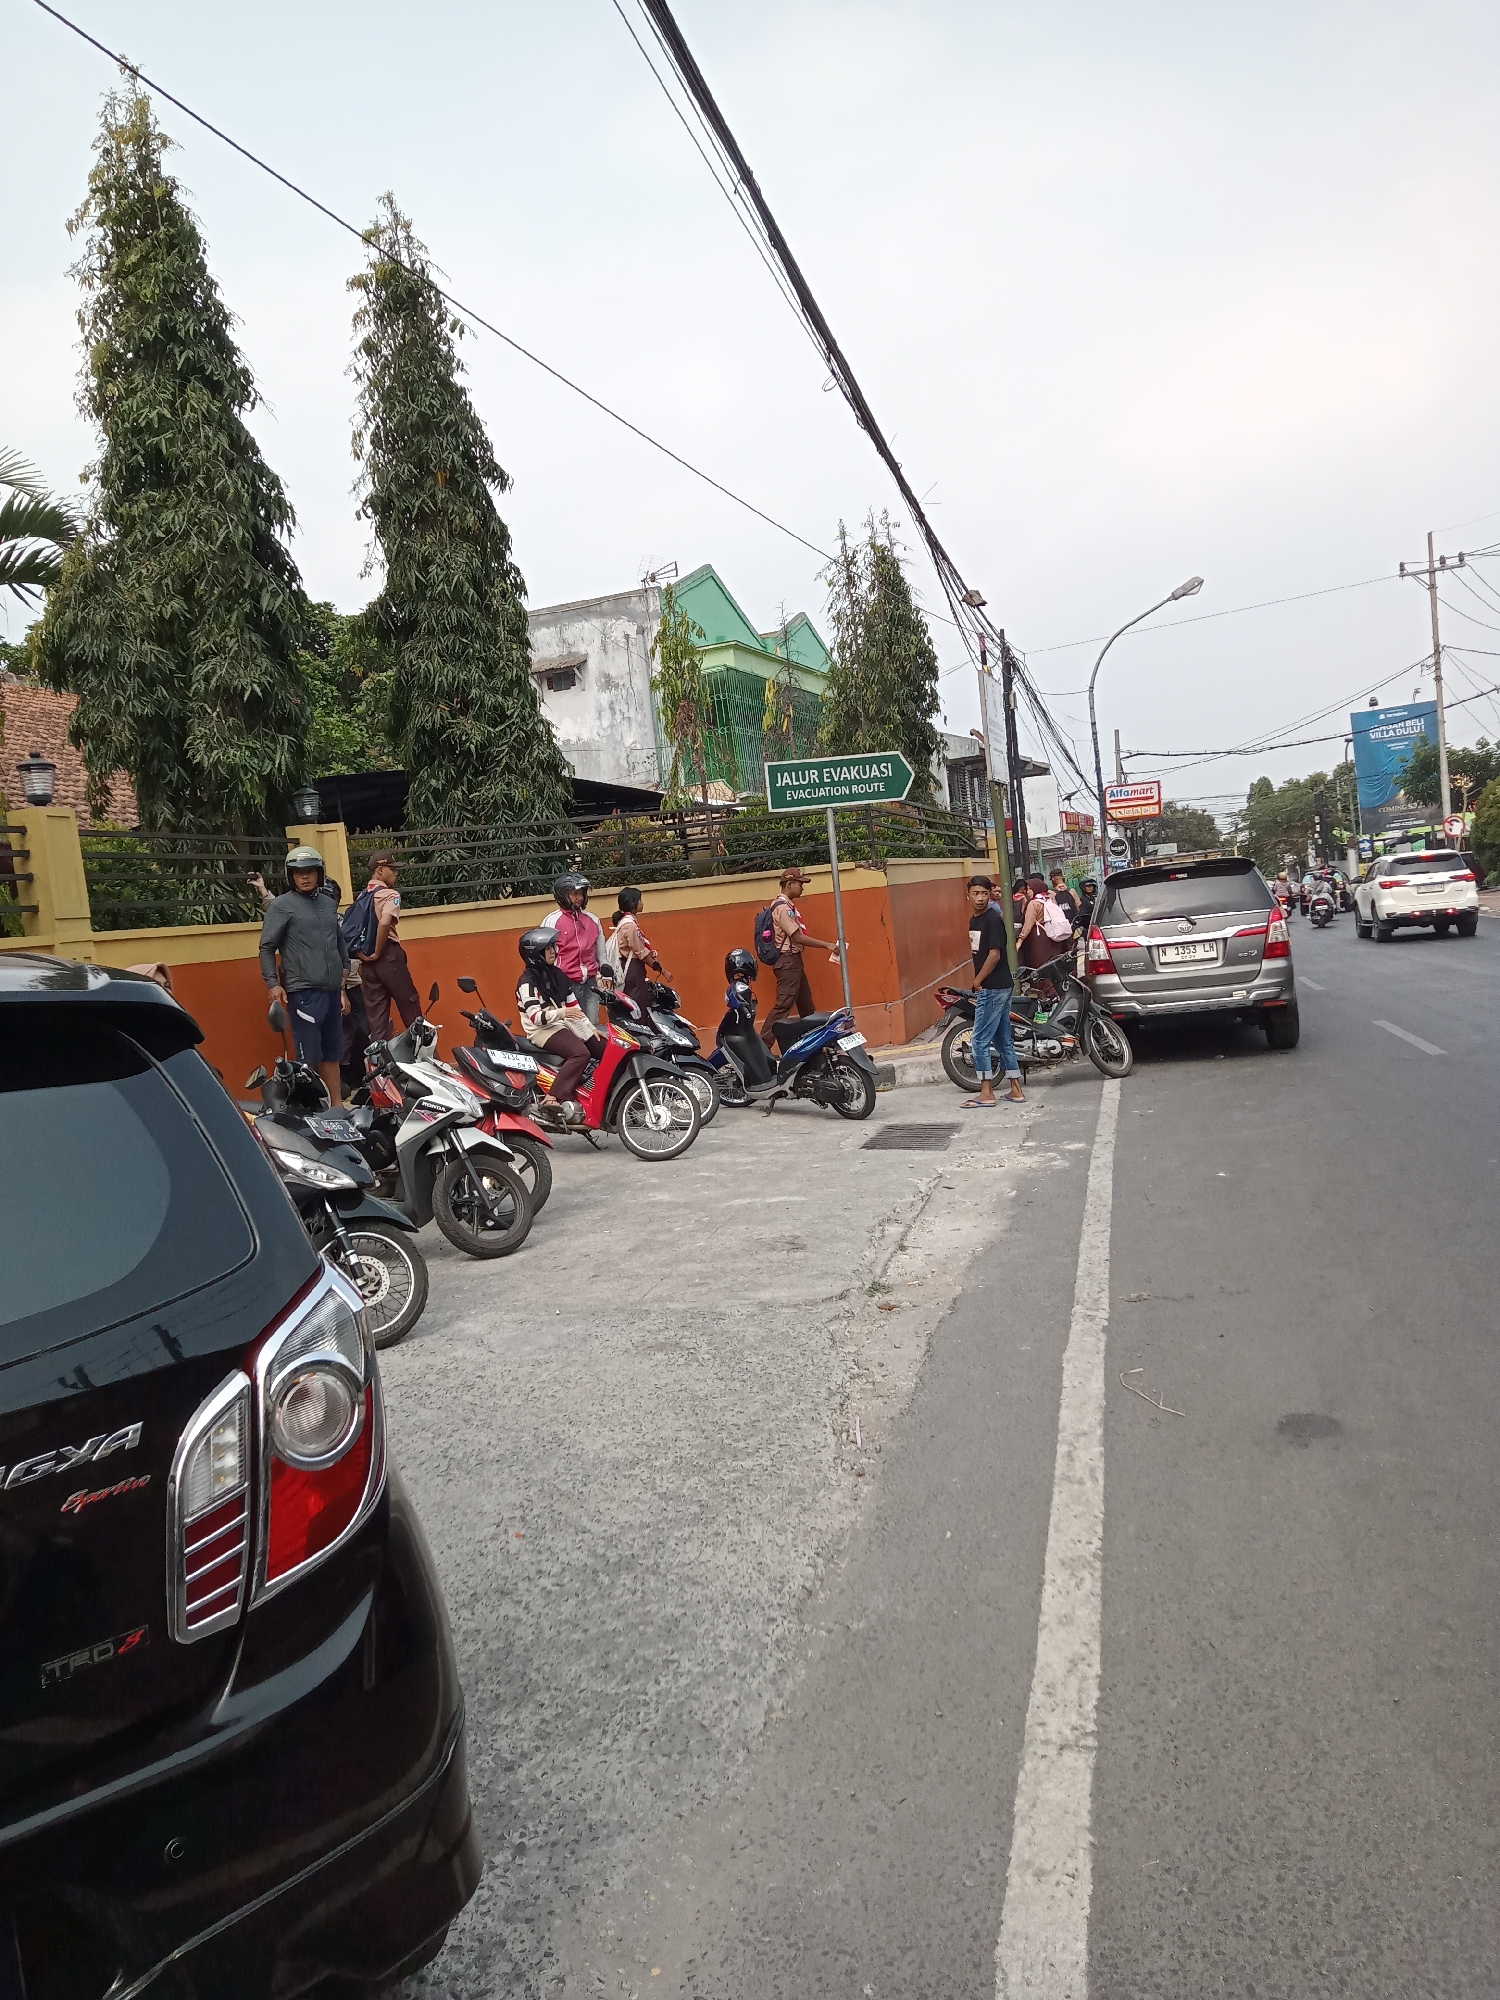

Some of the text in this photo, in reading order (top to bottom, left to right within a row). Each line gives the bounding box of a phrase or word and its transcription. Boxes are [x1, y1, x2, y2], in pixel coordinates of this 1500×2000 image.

[1405, 718, 1425, 727] BELI
[1370, 730, 1395, 739] VILLA
[776, 763, 892, 787] JALUR EVAKUASI
[786, 782, 886, 801] EVACUATION ROUTE
[1109, 786, 1154, 798] Alfamart
[1378, 804, 1407, 813] COMING
[1161, 942, 1215, 957] N 1353 LH
[421, 1101, 447, 1112] HONDA
